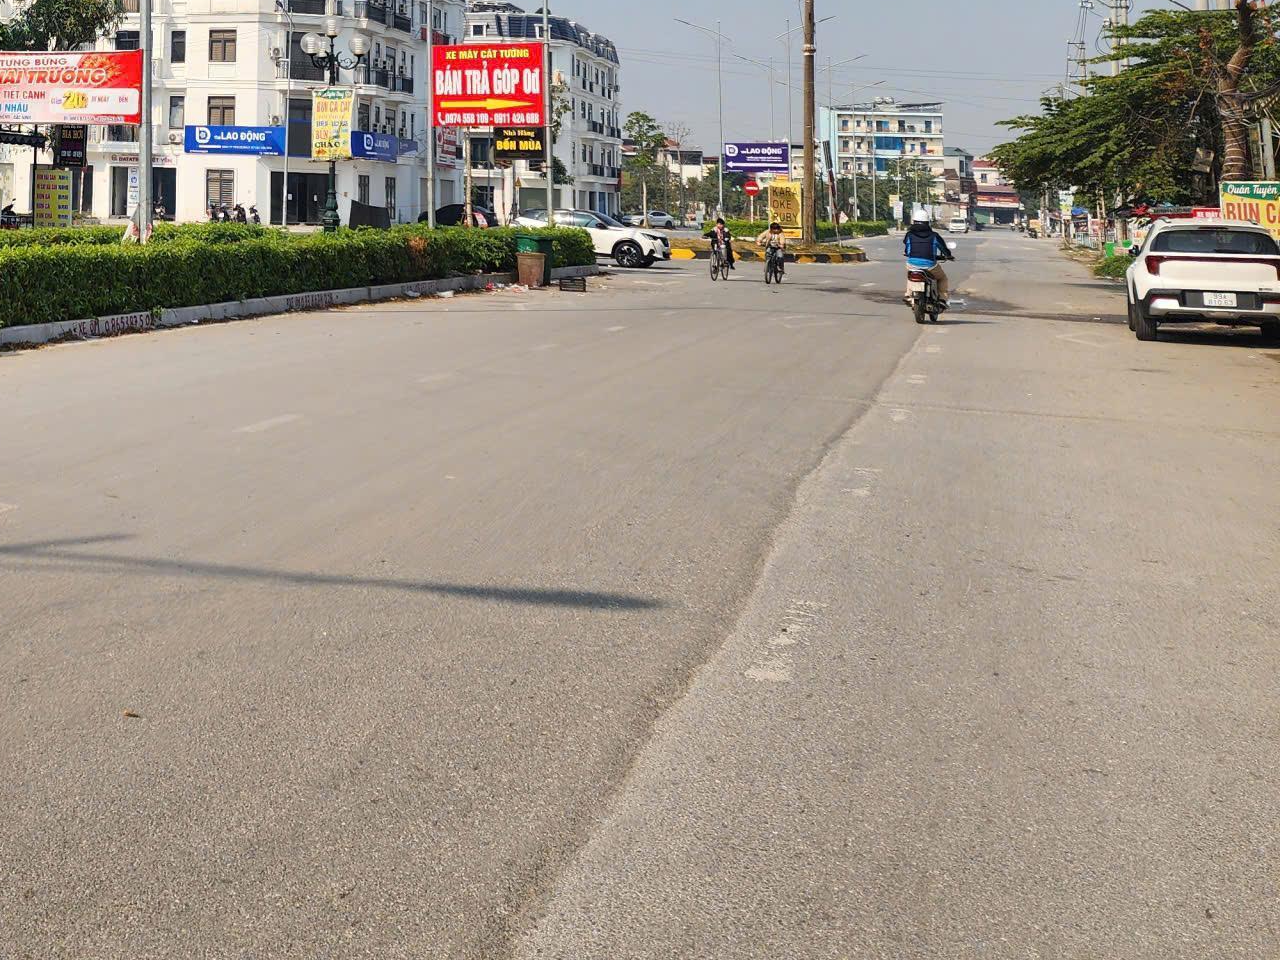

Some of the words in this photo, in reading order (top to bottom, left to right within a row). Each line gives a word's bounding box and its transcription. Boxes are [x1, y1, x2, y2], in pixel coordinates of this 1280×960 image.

[446, 51, 457, 59] XE
[459, 49, 478, 59] MÁY
[480, 48, 498, 58] CÁT
[27, 68, 107, 85] TRƯƠNG
[435, 64, 462, 95] BÁN
[464, 60, 490, 95] TRẢ
[493, 63, 520, 95] GÓP
[22, 90, 46, 100] CANH
[220, 132, 238, 141] LAO
[240, 130, 266, 142] ĐỘNG
[496, 137, 517, 150] BỐN
[518, 138, 542, 150] MÙA
[772, 186, 798, 197] KARA
[1227, 183, 1250, 195] Quán
[772, 199, 792, 209] OKE
[772, 212, 798, 222] RUBY
[1266, 202, 1280, 225] C
